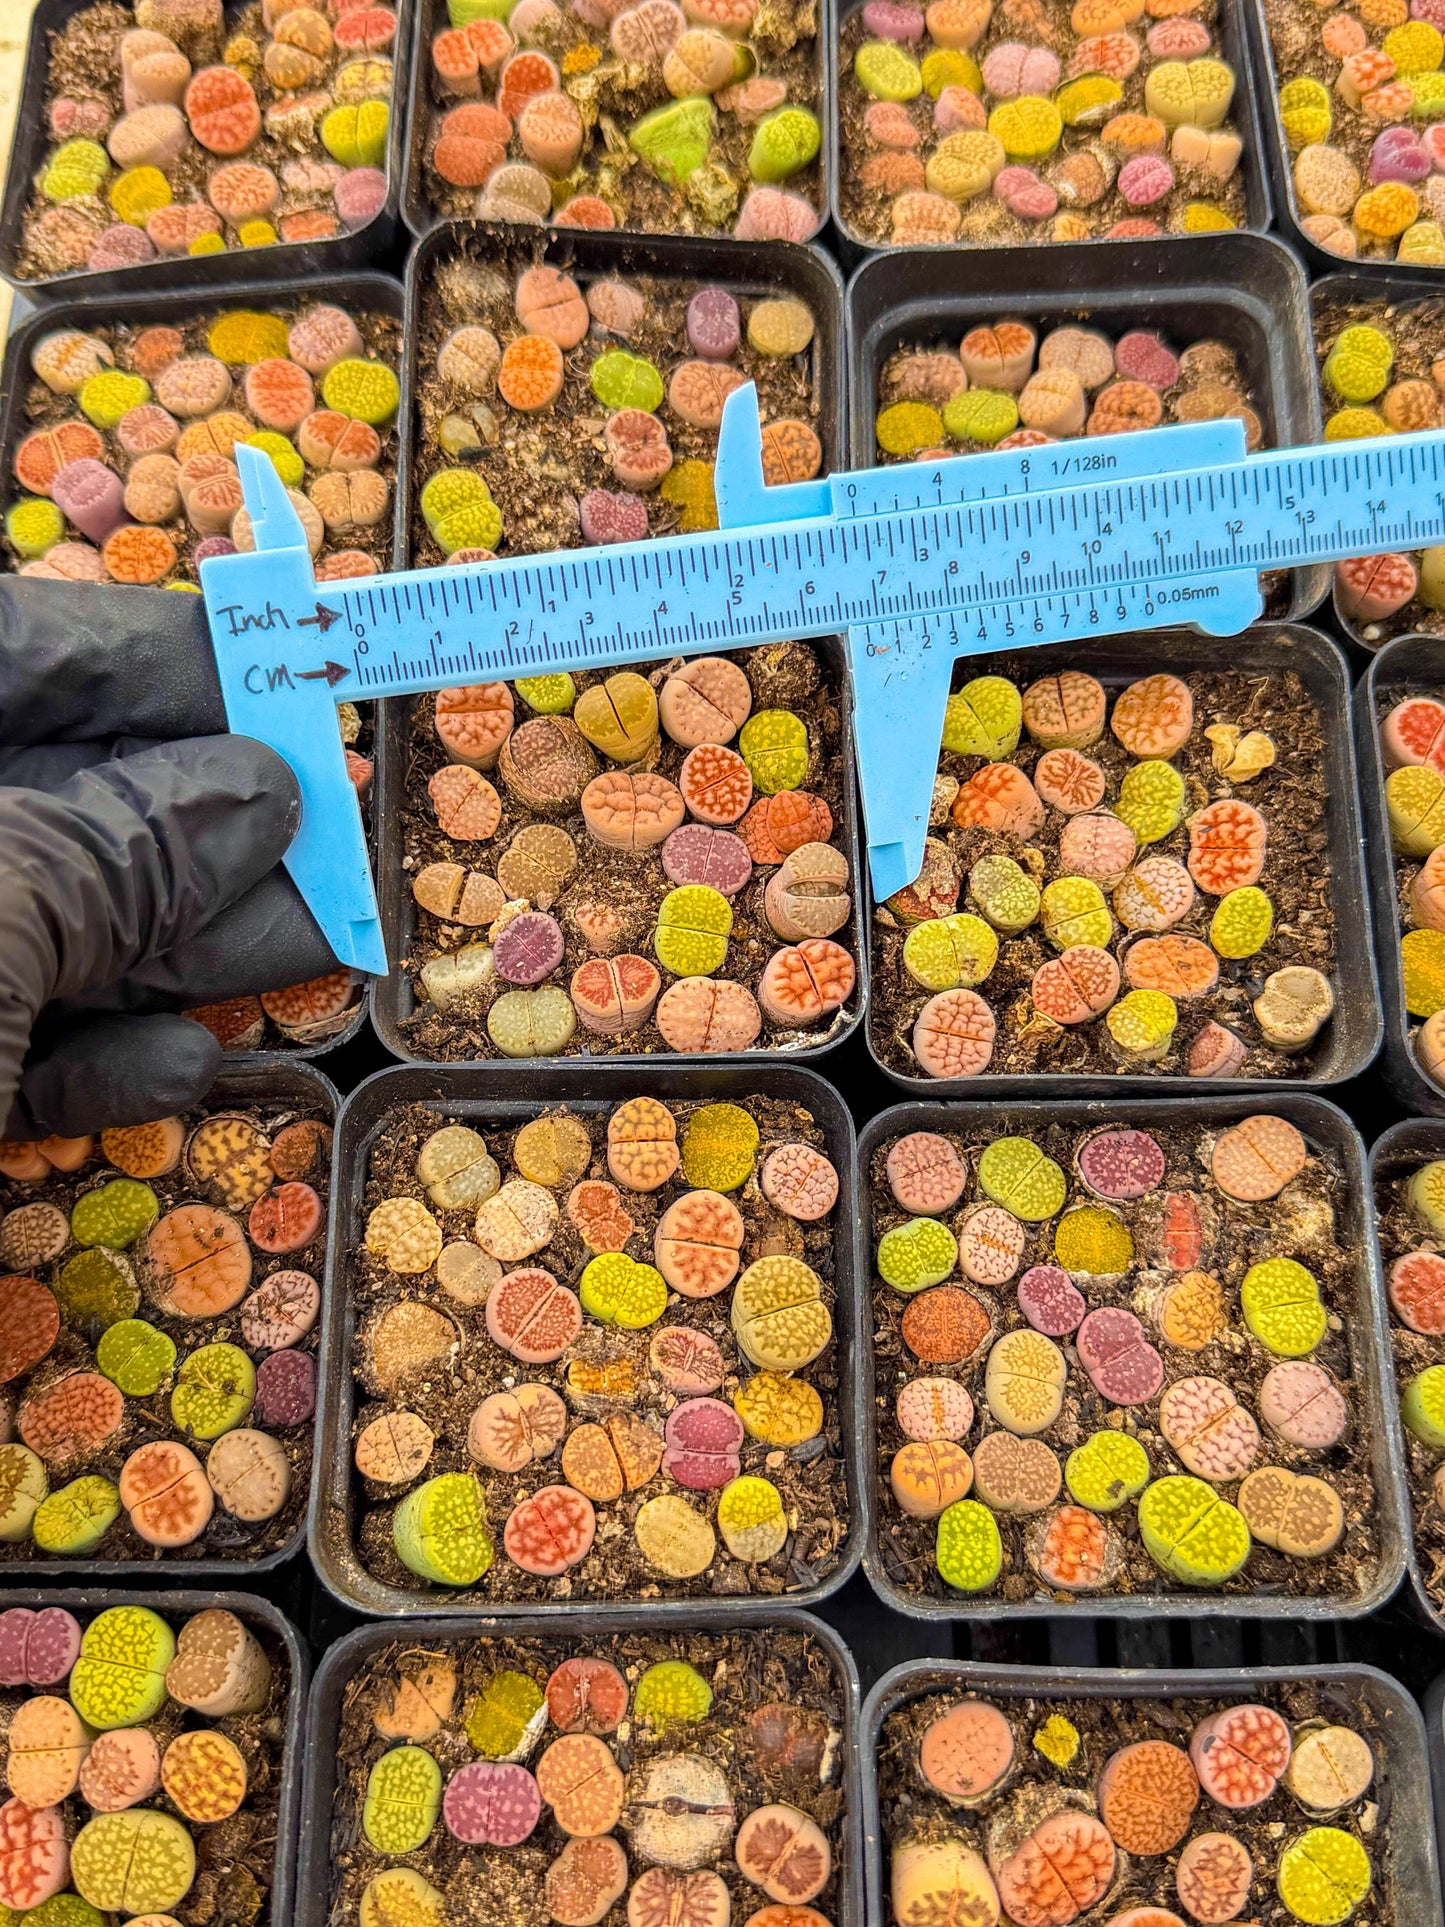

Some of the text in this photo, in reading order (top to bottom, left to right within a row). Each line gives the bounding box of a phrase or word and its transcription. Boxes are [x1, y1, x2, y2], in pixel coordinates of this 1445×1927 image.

[848, 484, 857, 498] 0
[931, 472, 943, 486] 4
[1020, 459, 1031, 474] 8
[354, 496, 1296, 638] 0 1 2 3 4 5
[358, 641, 369, 655] 0
[434, 631, 443, 645] 1
[509, 621, 519, 635] 2
[585, 611, 595, 625] 3
[657, 601, 668, 615] 4
[732, 591, 743, 605] 5
[804, 581, 816, 595] 6
[877, 570, 888, 585] 7
[948, 561, 959, 575] 8
[1021, 551, 1031, 565] 9
[1081, 539, 1103, 555] 10
[1152, 529, 1172, 545] 11
[1225, 520, 1244, 535] 12
[1295, 510, 1316, 525] 13
[1366, 499, 1387, 515] 14
[216, 601, 290, 637] Inch
[866, 585, 1220, 658] 0 1 2 3 4 5 6 7 8 9 0 0.05mm
